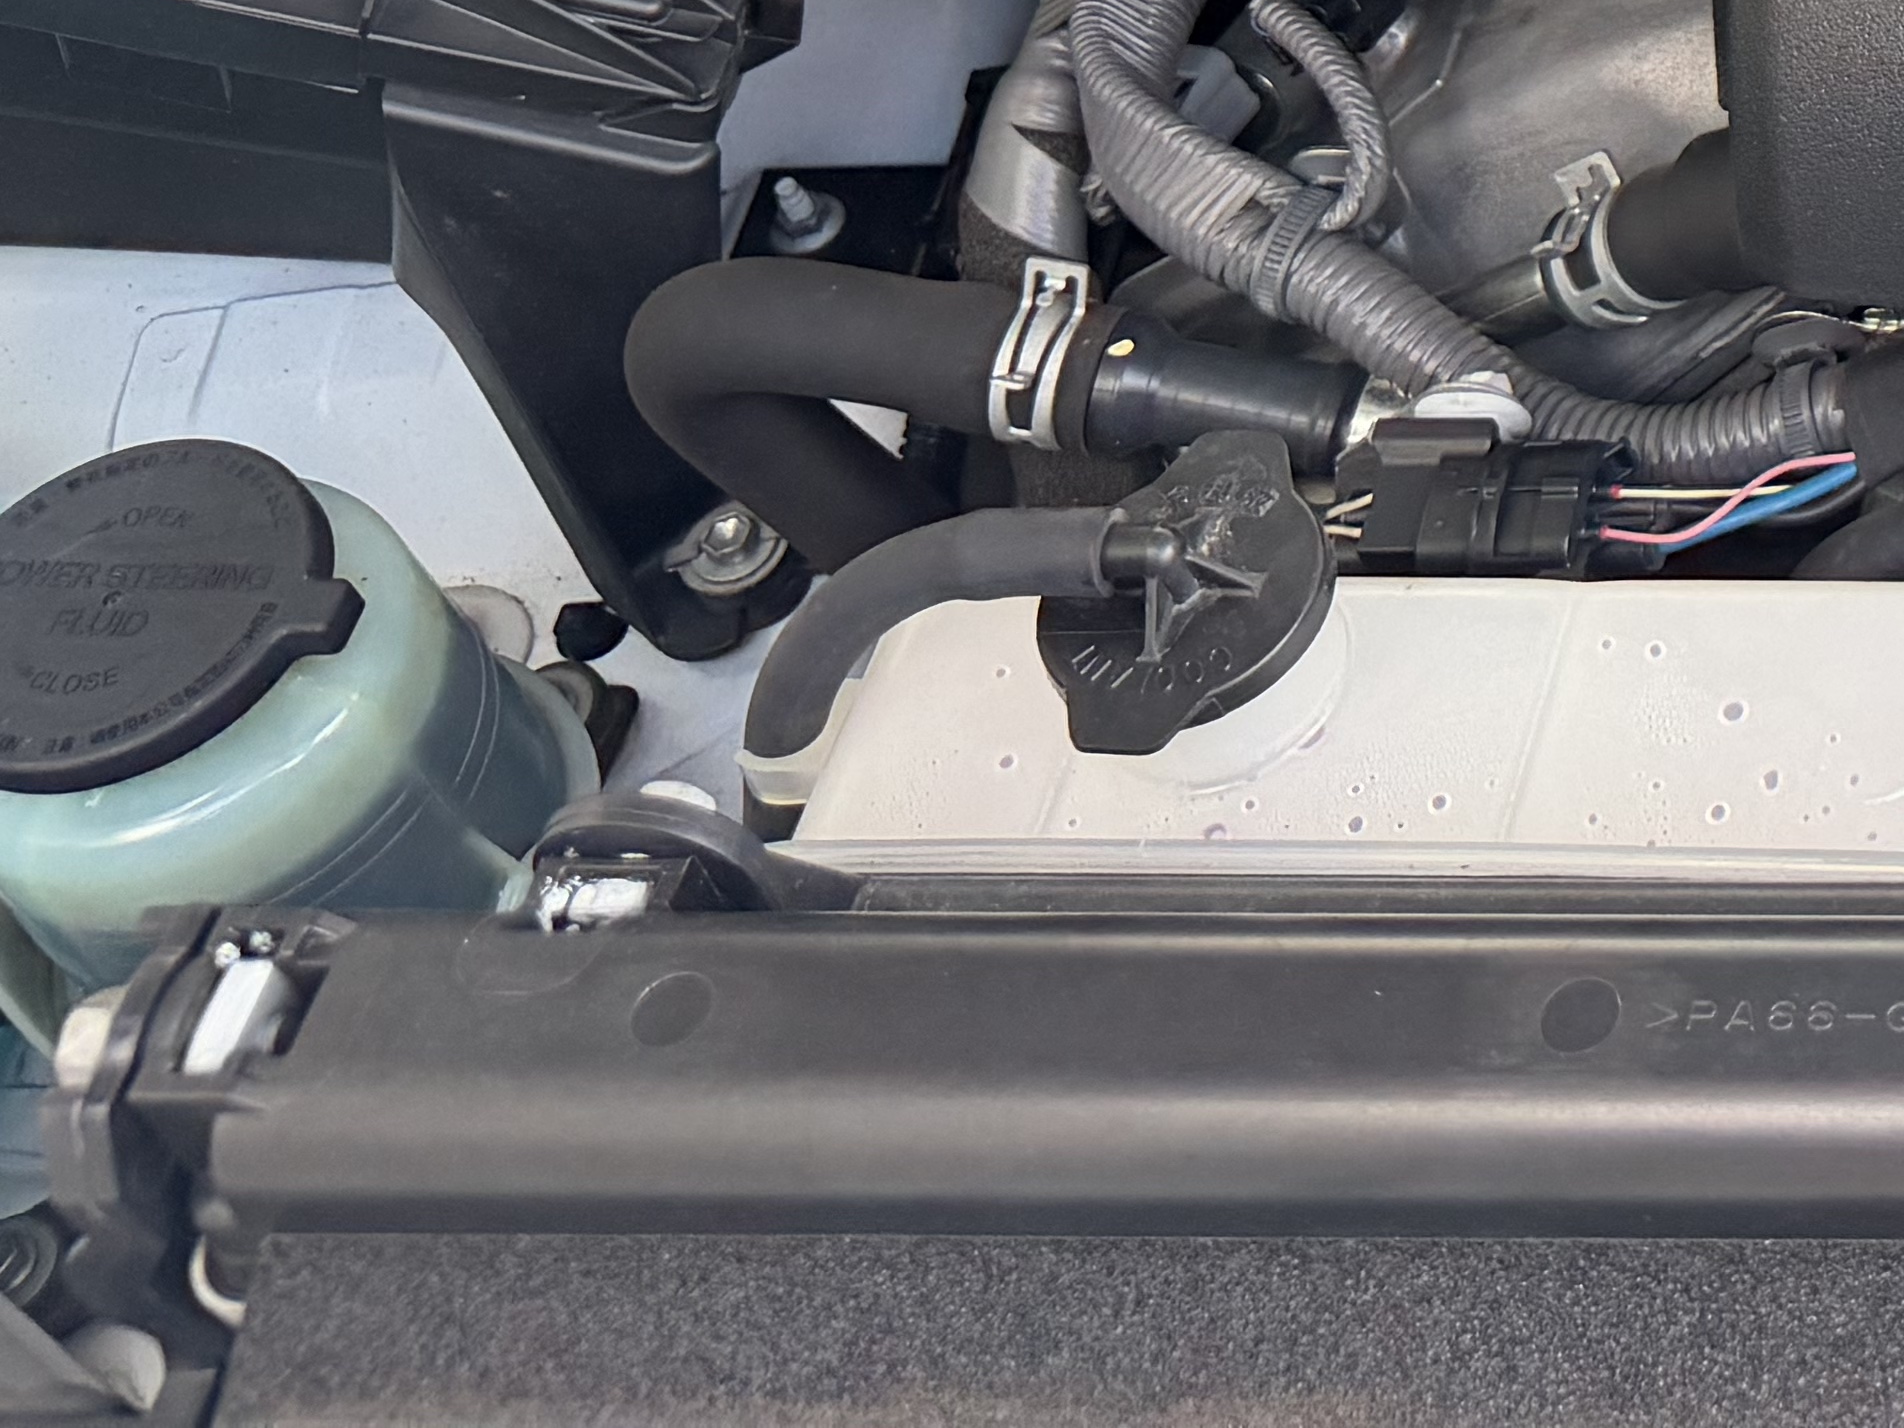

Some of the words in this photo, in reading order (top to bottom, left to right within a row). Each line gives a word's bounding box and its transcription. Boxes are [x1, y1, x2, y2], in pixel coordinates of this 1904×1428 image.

[120, 505, 194, 531] OPEN
[104, 562, 274, 591] STEERING
[45, 607, 150, 638] FLUID
[29, 665, 121, 695] CLOSE
